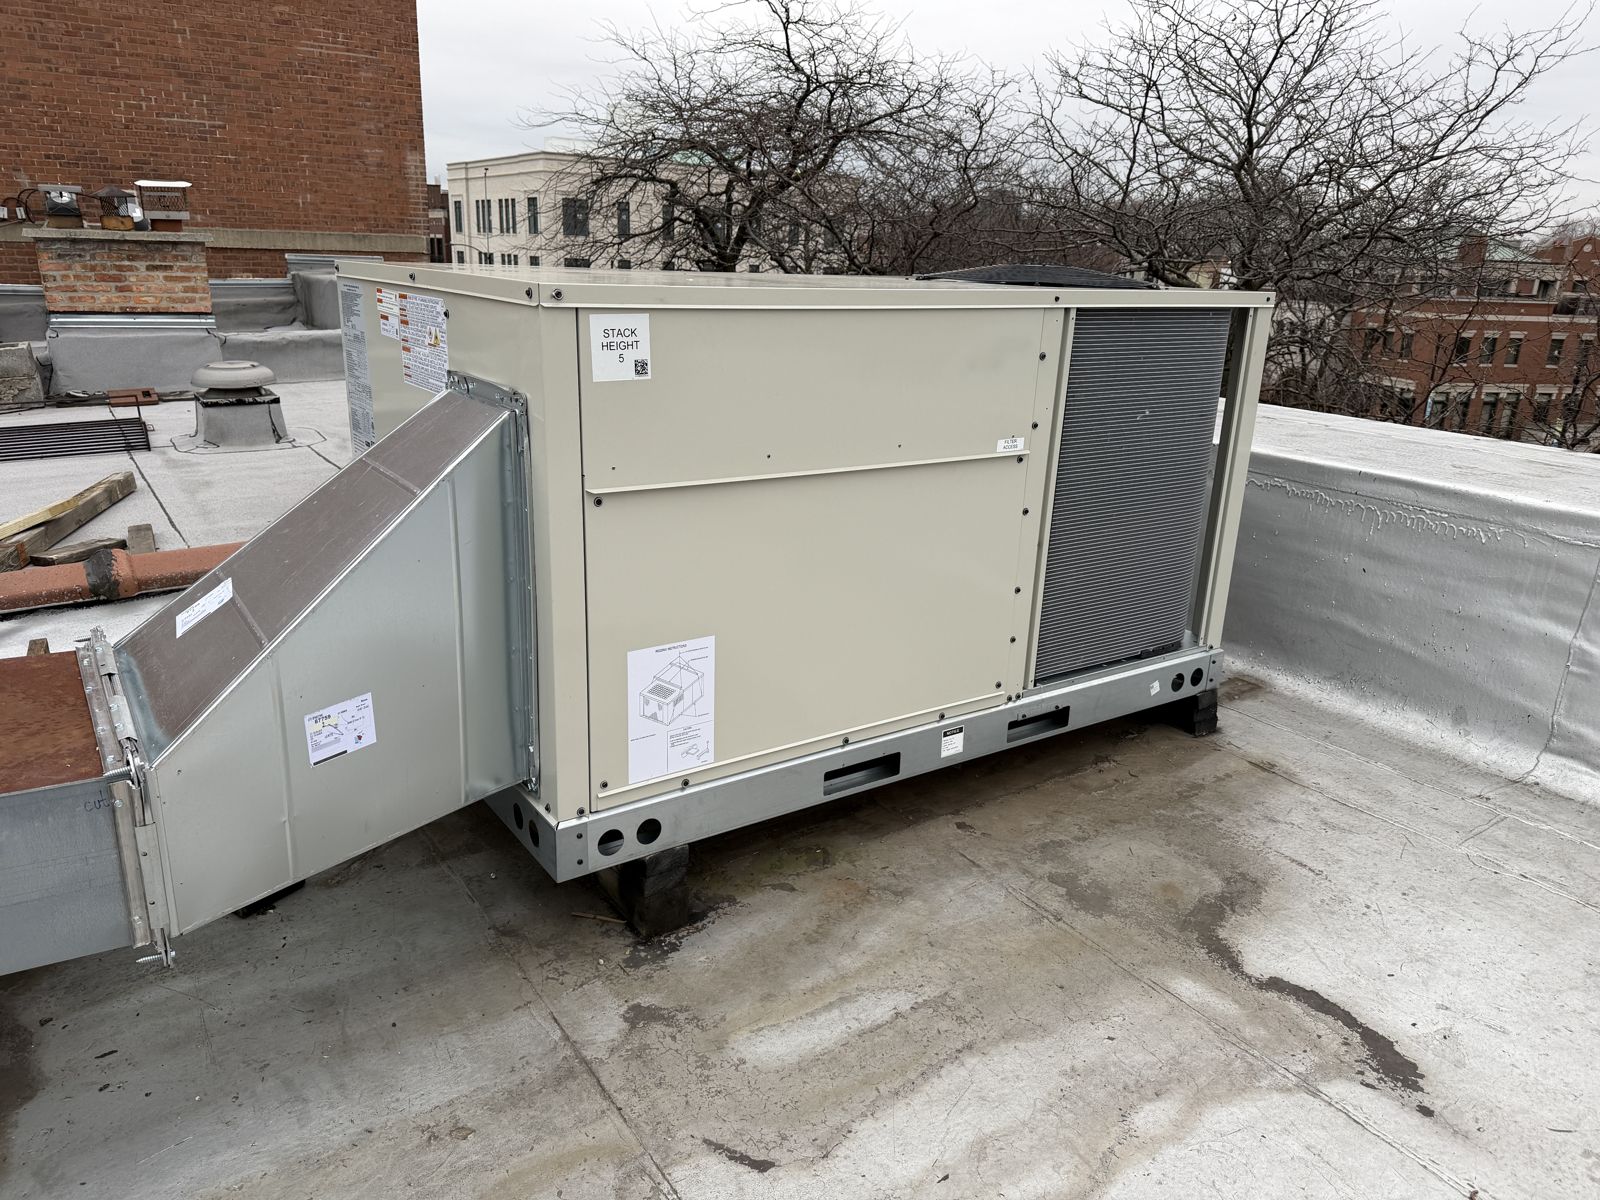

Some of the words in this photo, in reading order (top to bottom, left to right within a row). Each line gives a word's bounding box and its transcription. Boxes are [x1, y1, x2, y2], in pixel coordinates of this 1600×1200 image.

[602, 327, 638, 339] STACK
[601, 340, 640, 351] HEIGHT
[618, 353, 625, 363] 5
